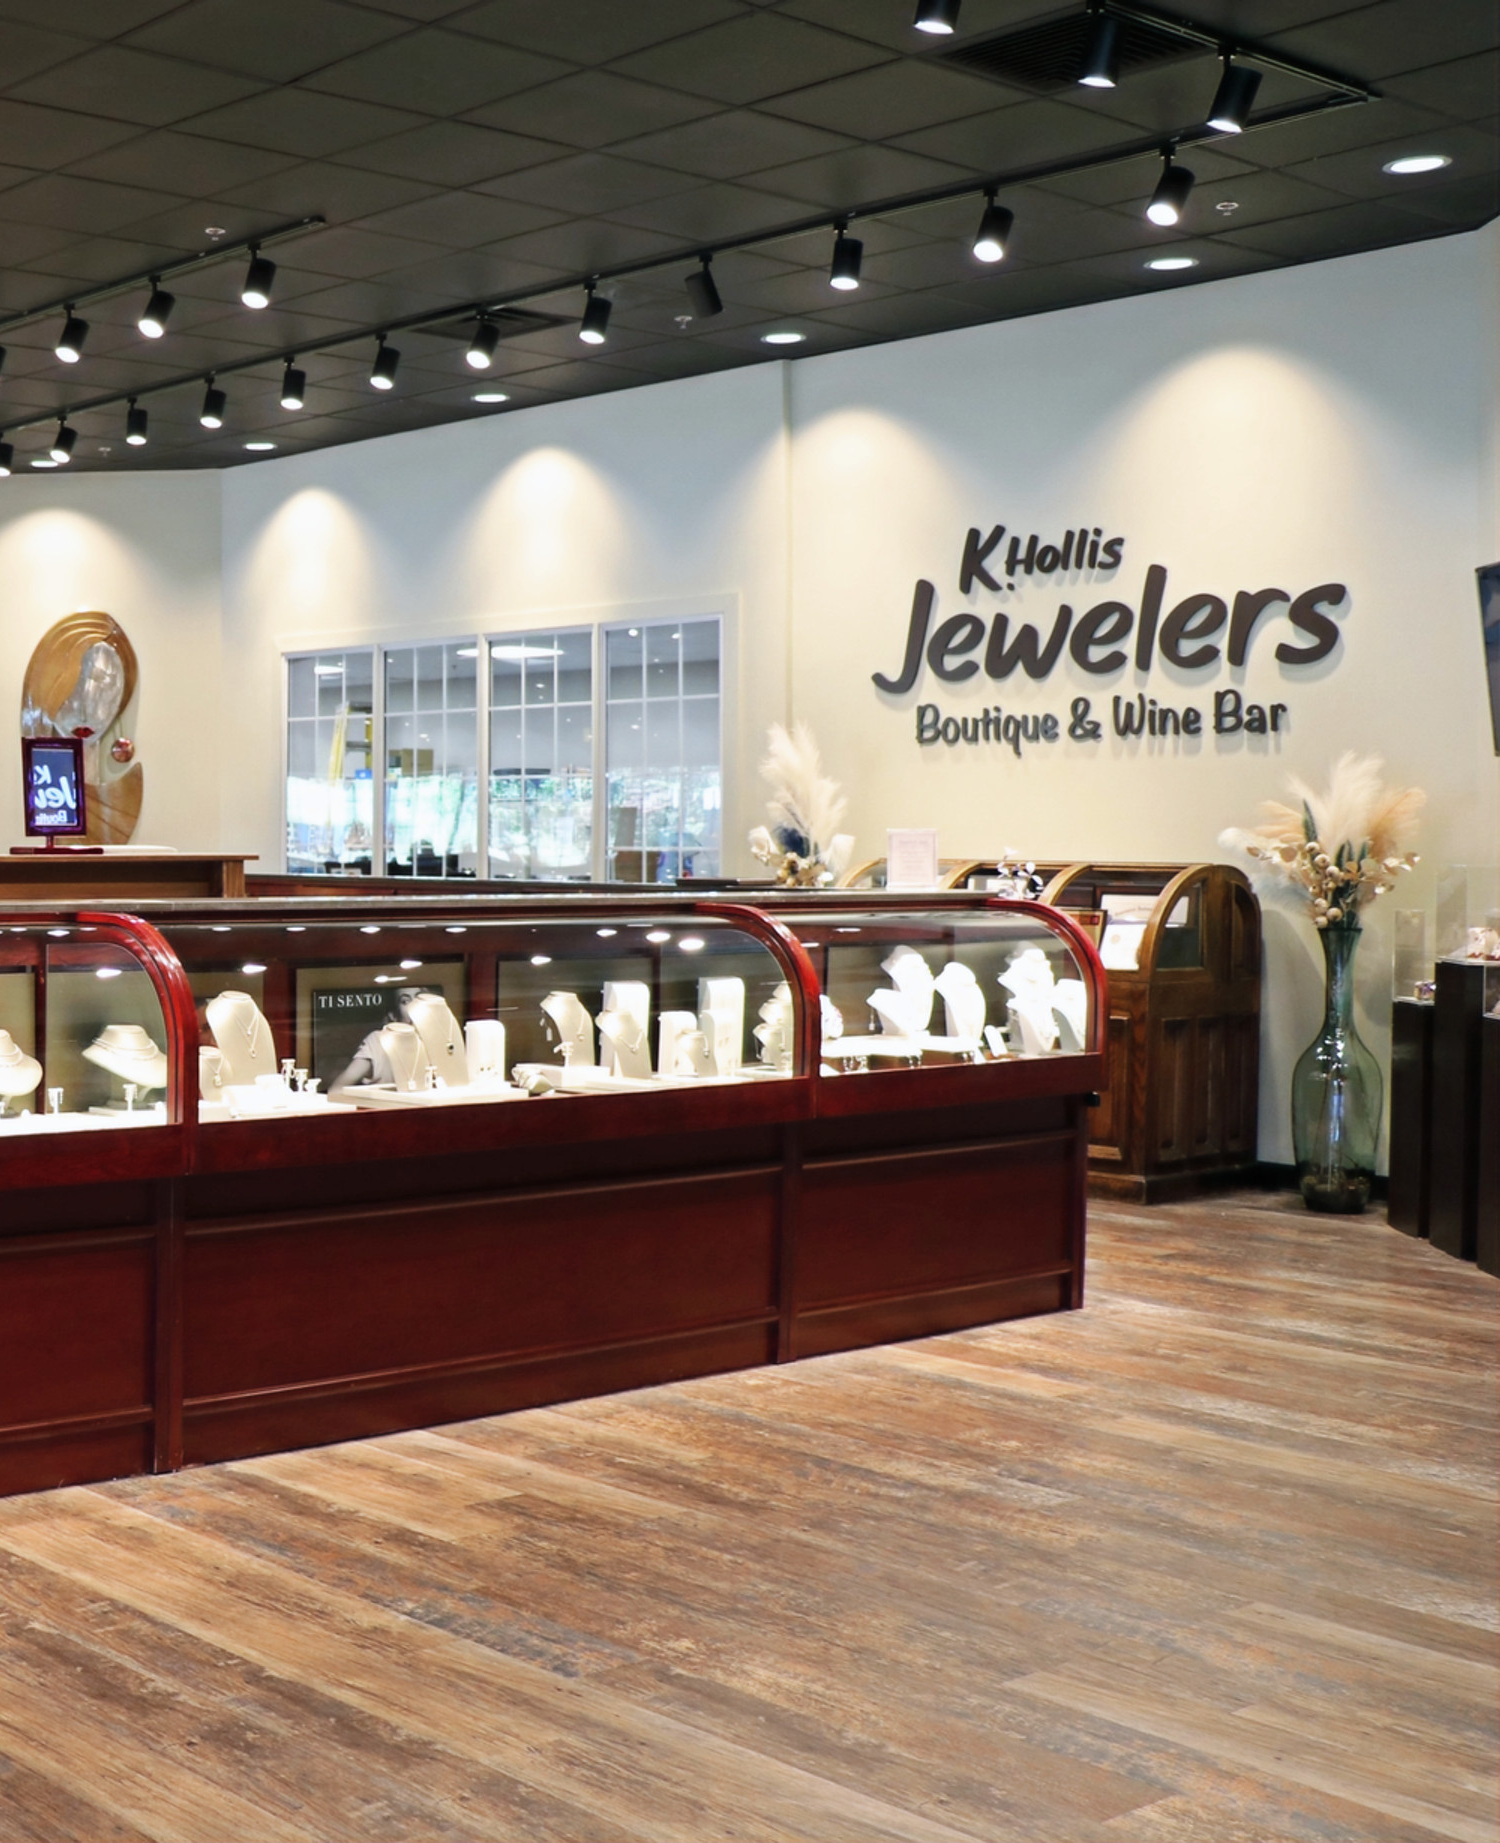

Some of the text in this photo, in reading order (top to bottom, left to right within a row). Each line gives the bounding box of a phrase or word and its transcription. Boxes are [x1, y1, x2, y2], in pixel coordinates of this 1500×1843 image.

[1005, 527, 1125, 577] Hollis
[871, 564, 1346, 694] Jewelers
[915, 688, 1288, 758] Boutique & Wine Bar
[318, 993, 382, 1009] TI SENTO
